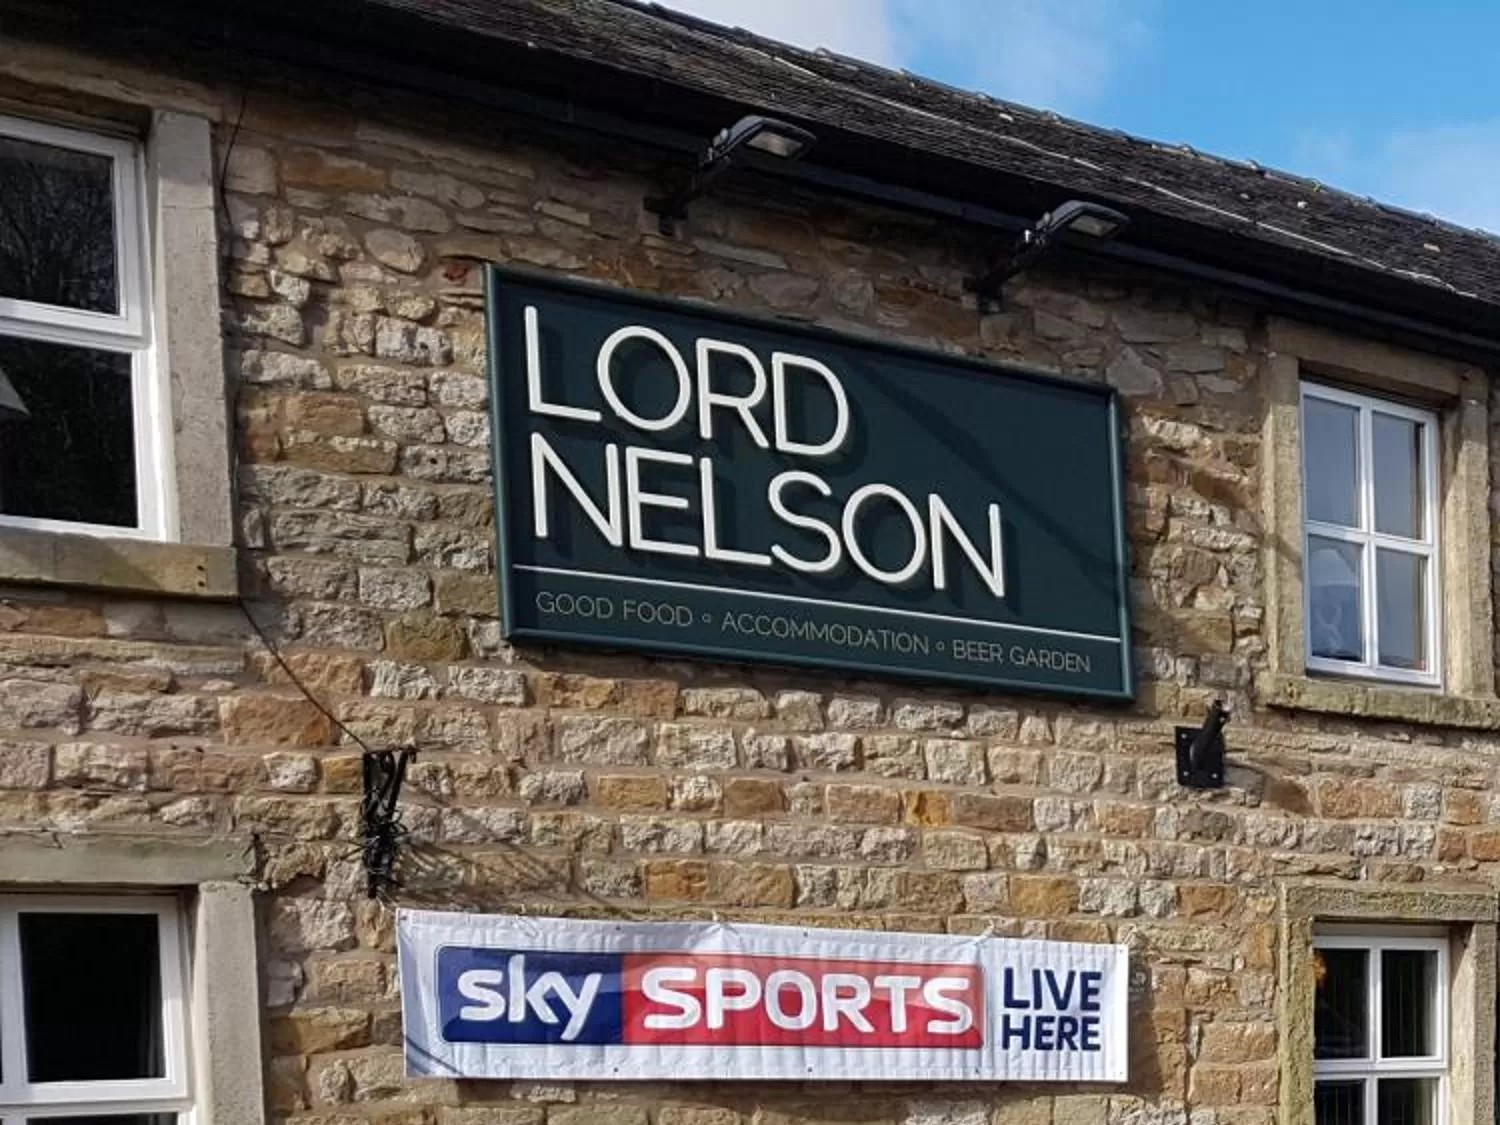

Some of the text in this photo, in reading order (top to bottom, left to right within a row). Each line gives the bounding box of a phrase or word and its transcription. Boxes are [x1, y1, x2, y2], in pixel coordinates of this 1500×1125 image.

[524, 305, 850, 456] LORD
[531, 432, 1005, 598] NELSON
[535, 591, 1092, 673] GOOD FOOD ACCOMMODATION BEER GARDEN
[456, 954, 975, 1041] sky SPORTS
[1002, 966, 1104, 1012] LIVE
[1002, 1014, 1102, 1051] HERE
